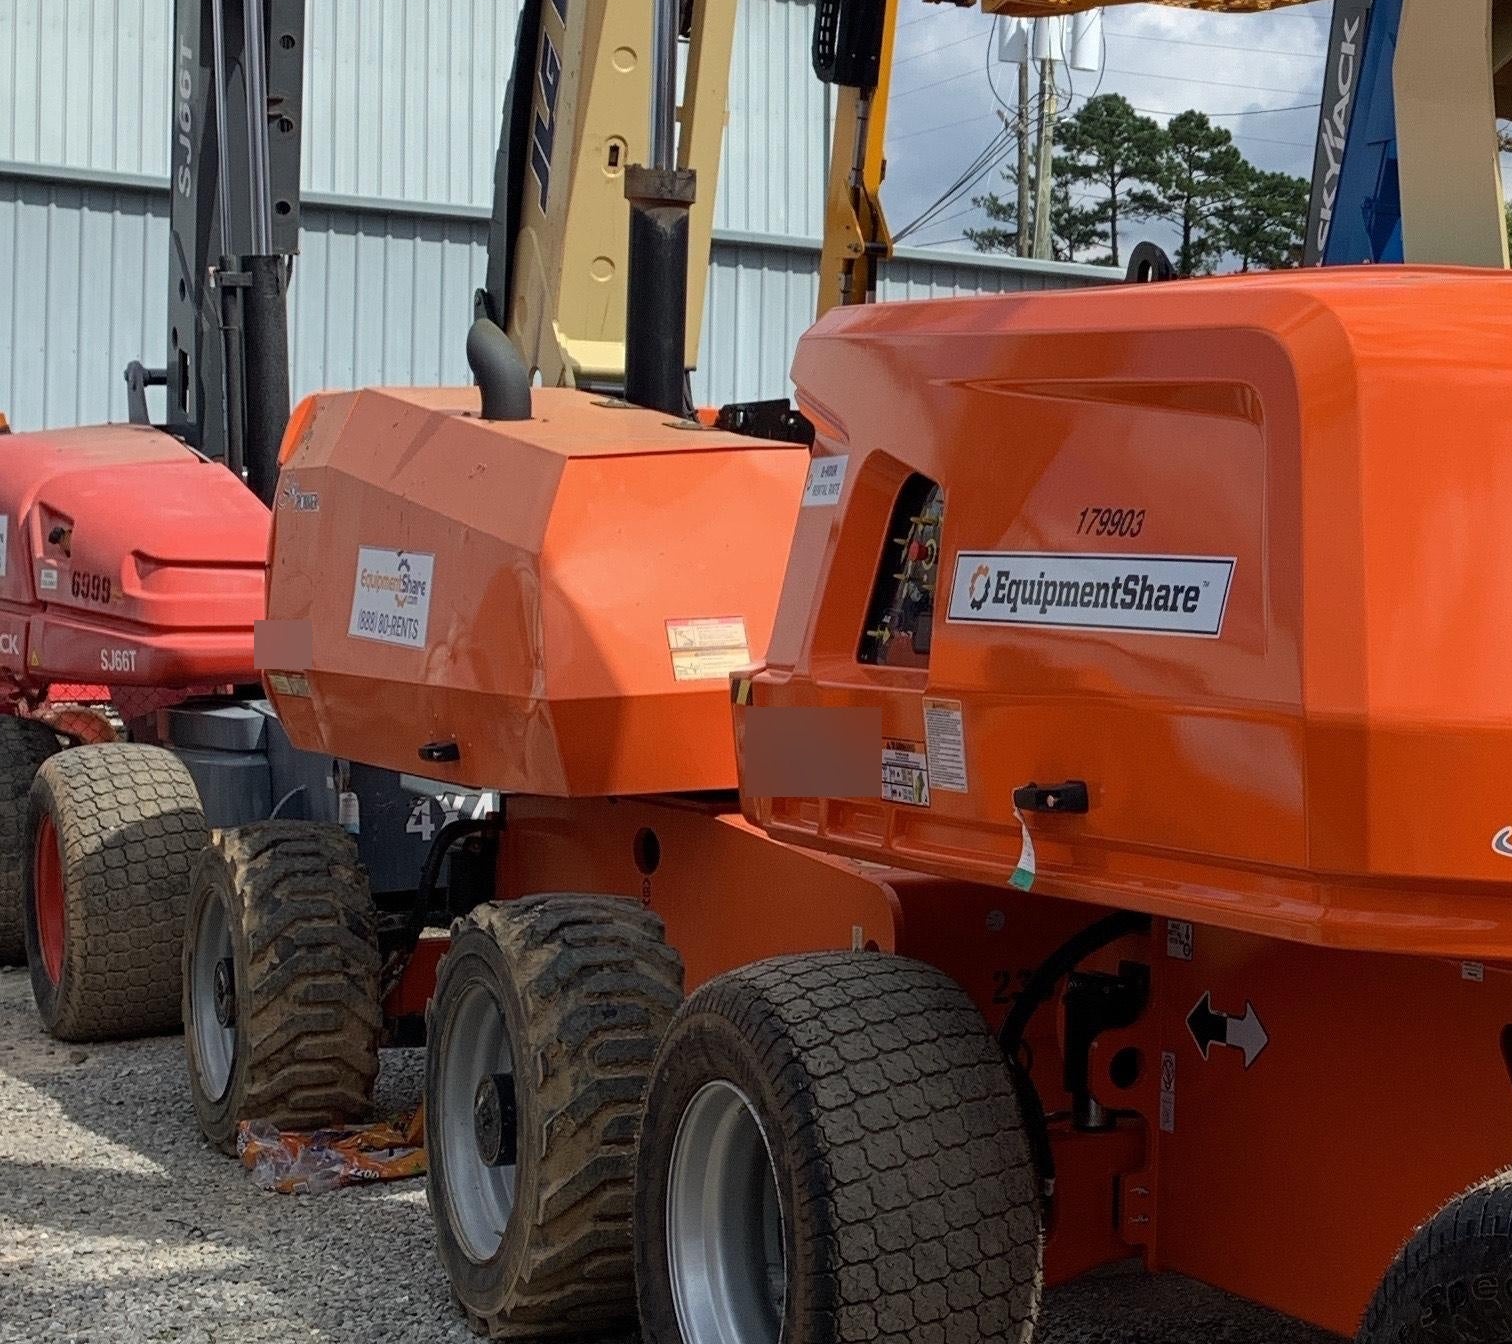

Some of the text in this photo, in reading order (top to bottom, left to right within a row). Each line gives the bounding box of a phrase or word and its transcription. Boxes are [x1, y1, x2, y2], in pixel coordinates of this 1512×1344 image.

[530, 26, 562, 219] JLG
[1075, 507, 1146, 538] 179903
[991, 569, 1201, 615] EquipmentShare
